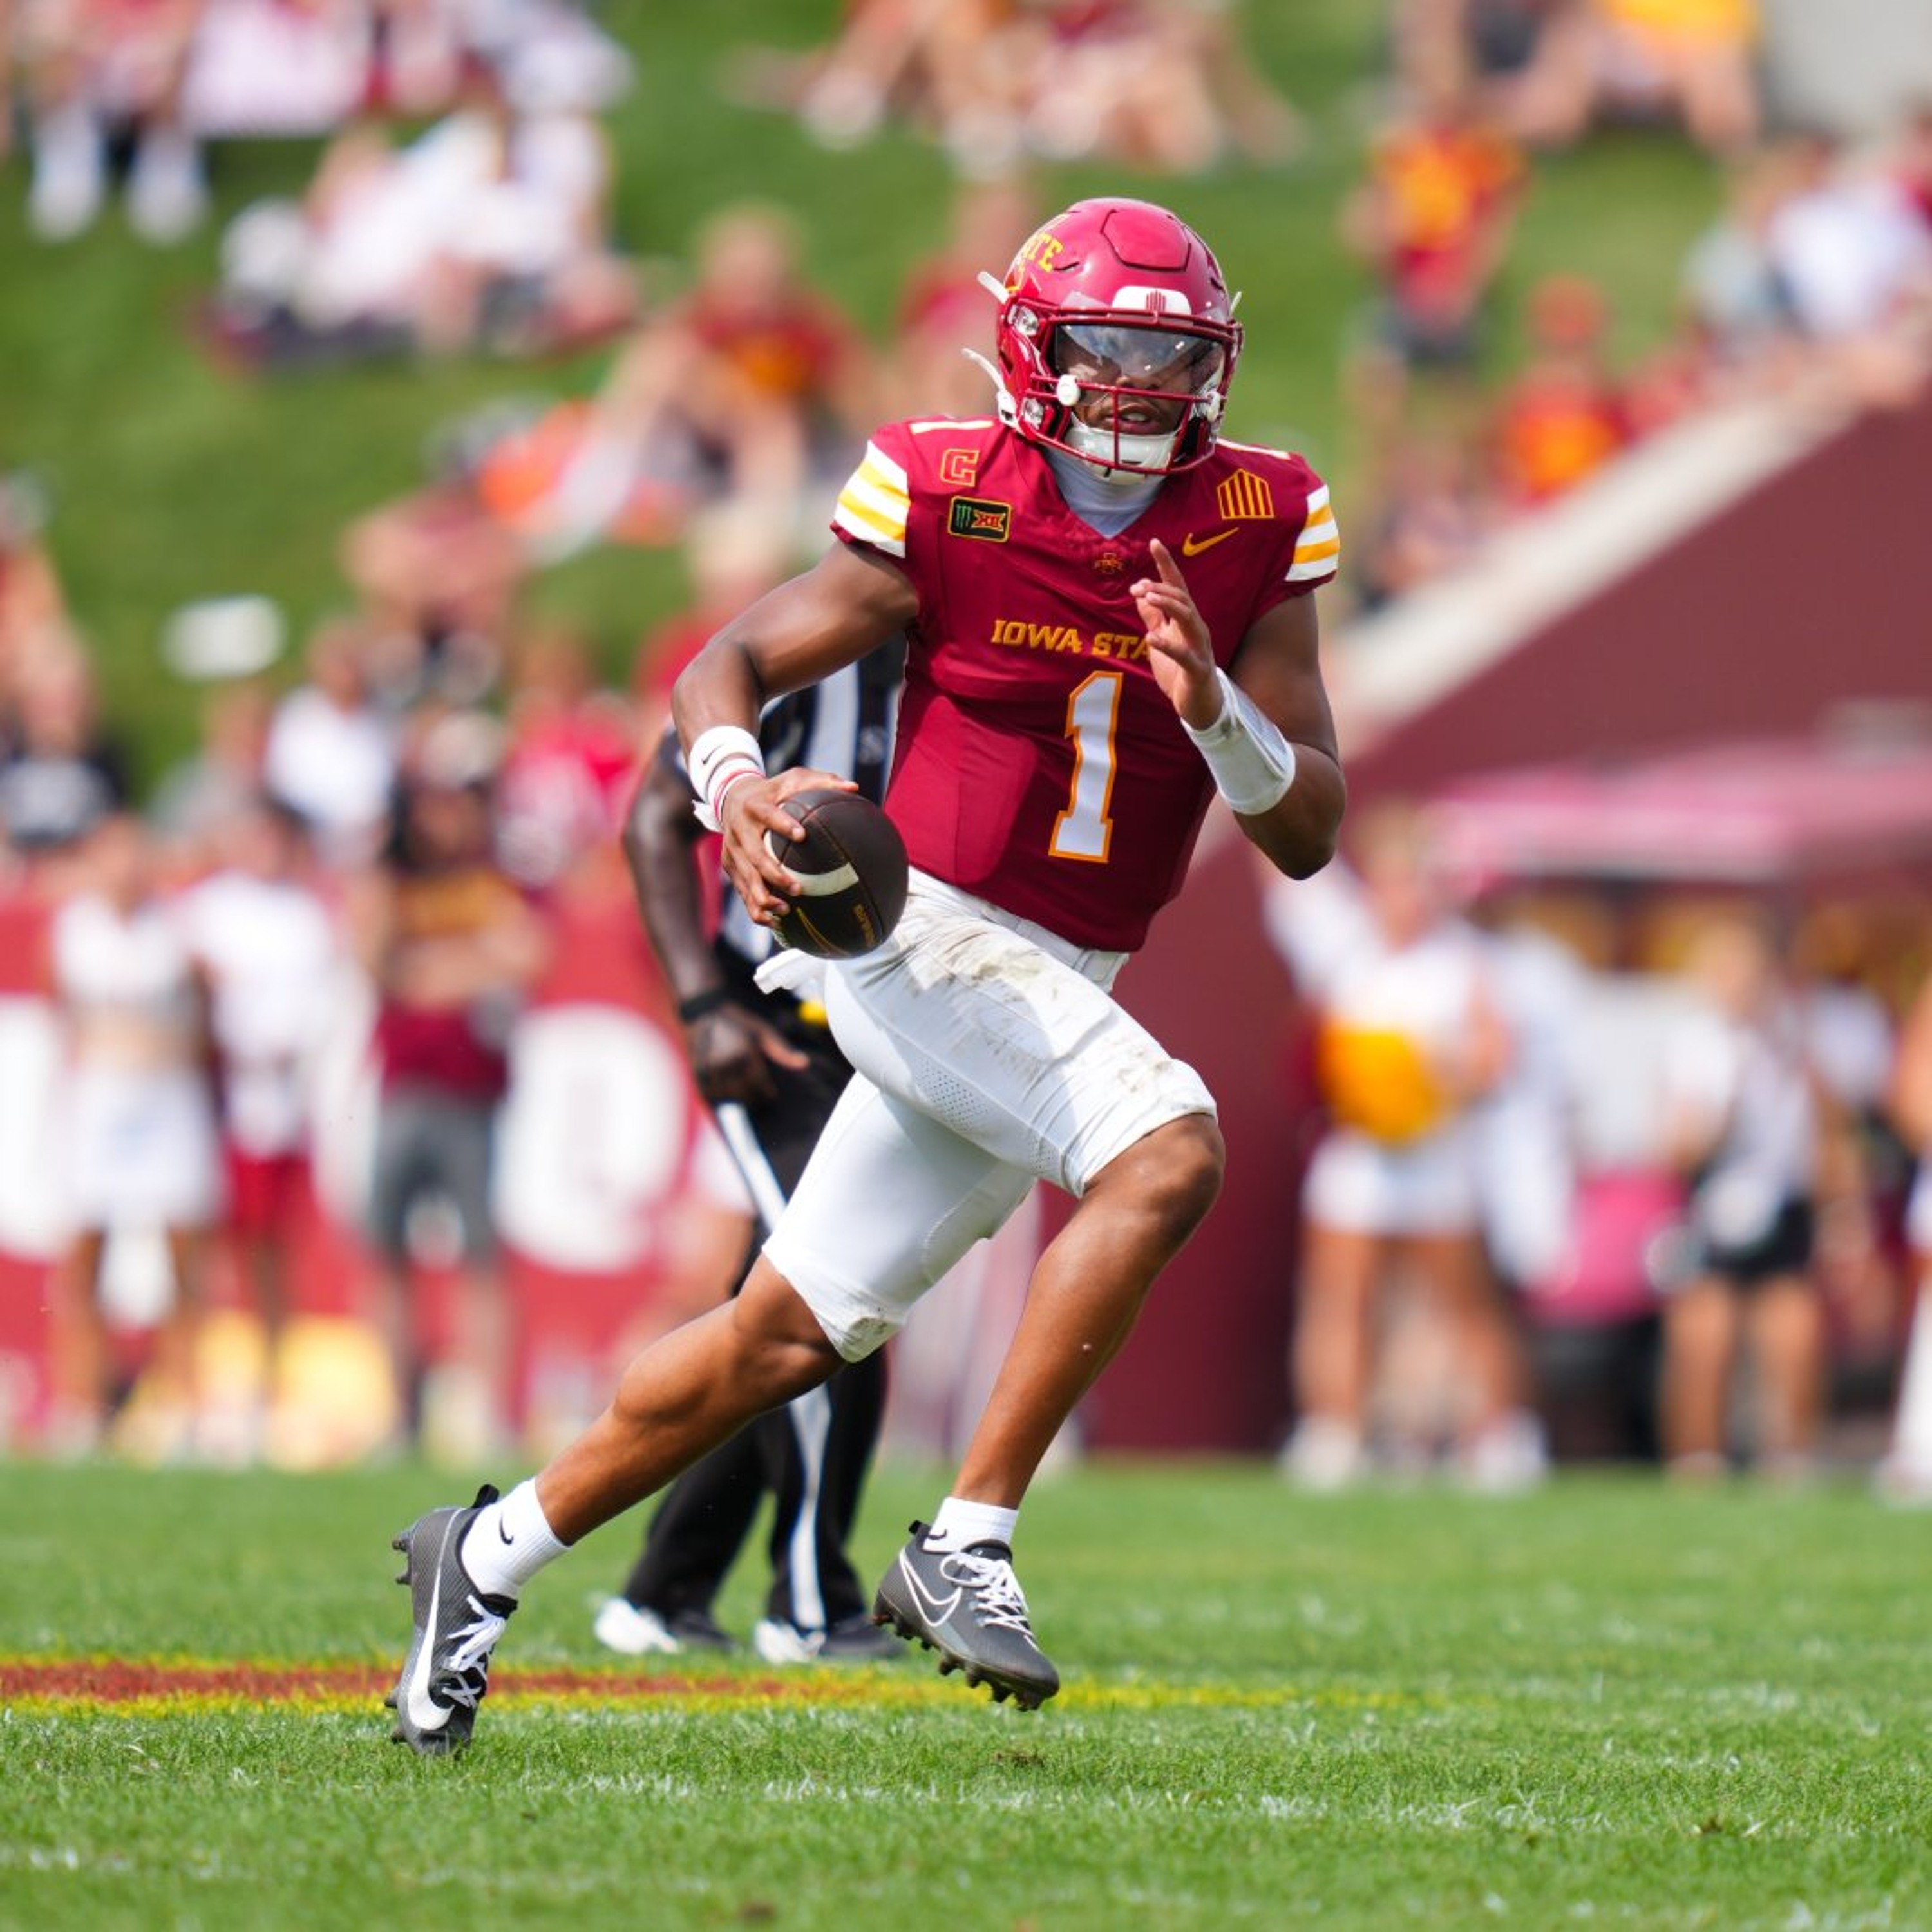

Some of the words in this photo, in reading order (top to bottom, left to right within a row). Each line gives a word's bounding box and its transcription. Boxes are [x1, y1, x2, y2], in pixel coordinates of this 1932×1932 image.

[940, 448, 979, 487] C
[991, 619, 1083, 654] IOWA
[1048, 670, 1124, 864] 1
